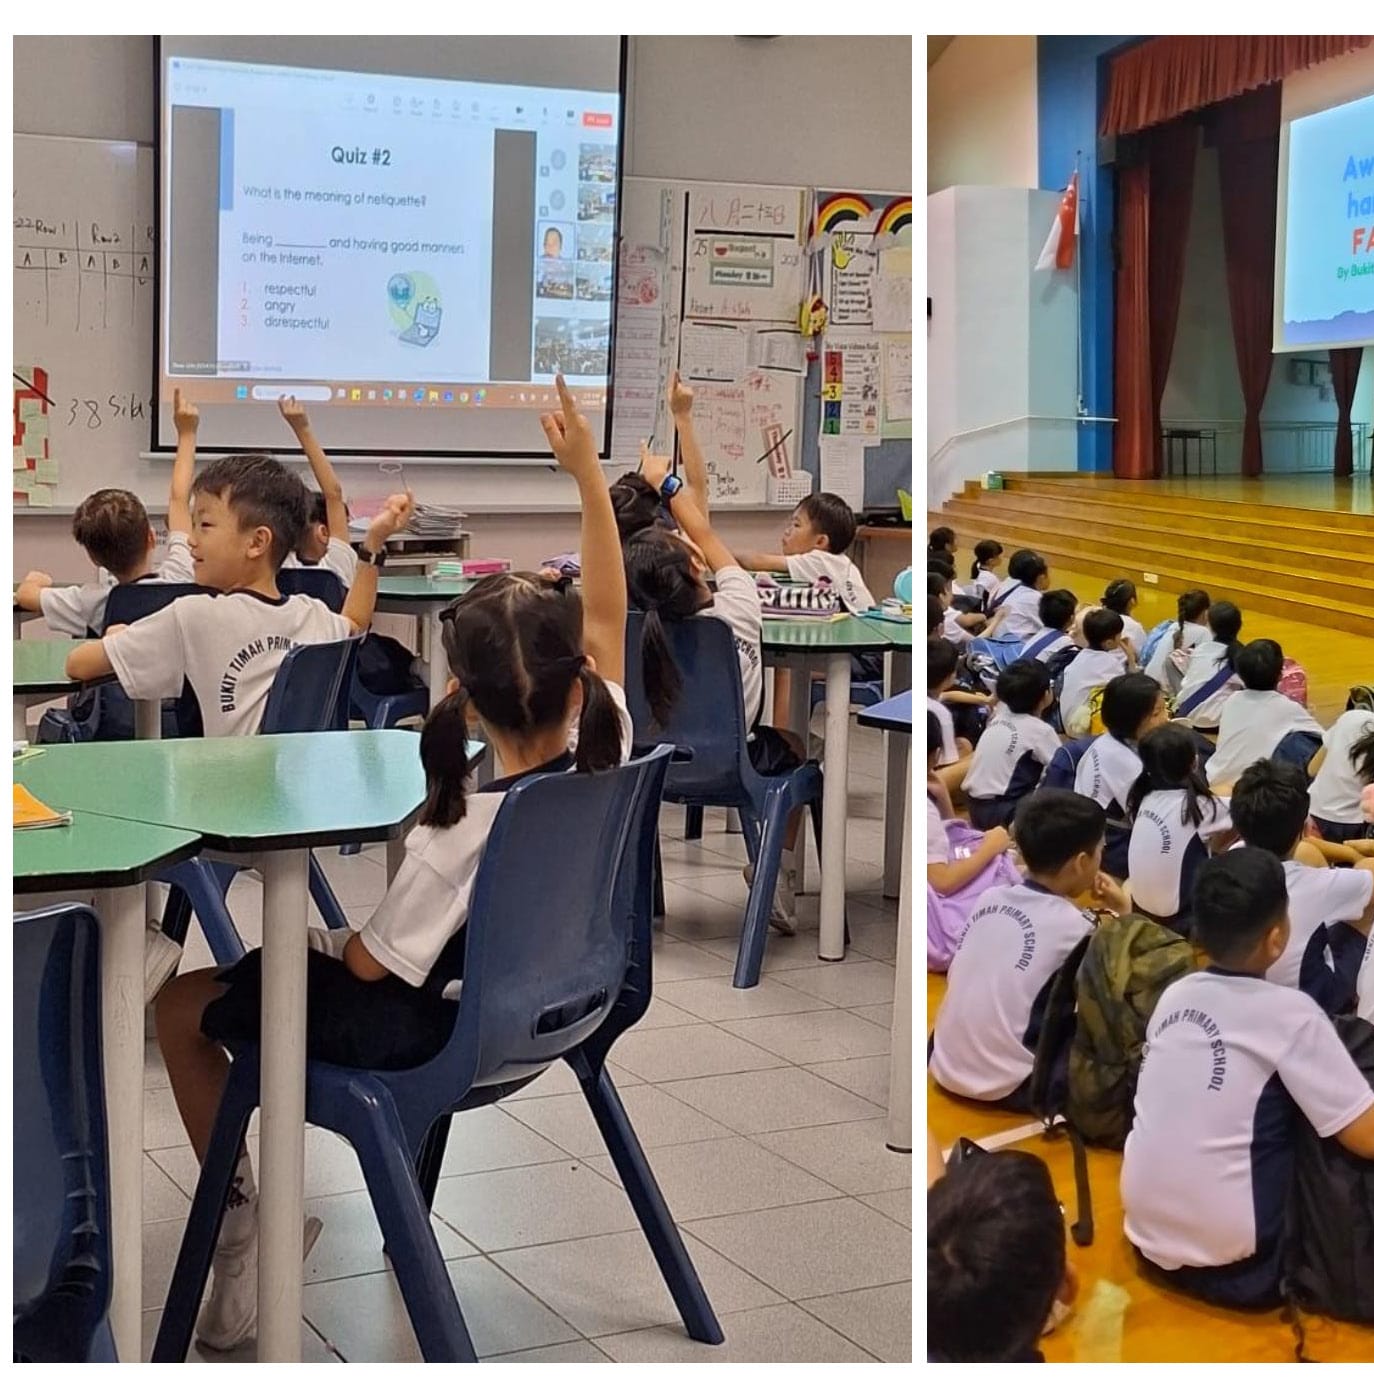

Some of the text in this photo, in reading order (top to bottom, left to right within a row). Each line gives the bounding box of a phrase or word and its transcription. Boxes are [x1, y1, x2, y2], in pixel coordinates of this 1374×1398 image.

[331, 146, 391, 165] Quiz #2
[243, 185, 426, 208] What is the meaning of netiquette?
[242, 232, 273, 246] Being
[329, 237, 350, 249] and
[353, 238, 388, 253] having
[390, 240, 419, 254] good
[242, 251, 324, 267] on the Internet.
[1337, 265, 1349, 281] By
[1351, 262, 1374, 277] Bukit
[264, 283, 317, 296] respectful
[264, 300, 296, 313] angry
[264, 316, 330, 330] disrespectful
[67, 398, 102, 429] 38
[220, 673, 238, 713] BUKIT
[229, 639, 265, 672] TIMAH
[999, 905, 1033, 931] PRIMARY
[1014, 931, 1036, 972] SCHOOL
[1182, 1008, 1221, 1039] PRIMARY
[1207, 1039, 1227, 1091] SCHOOL
